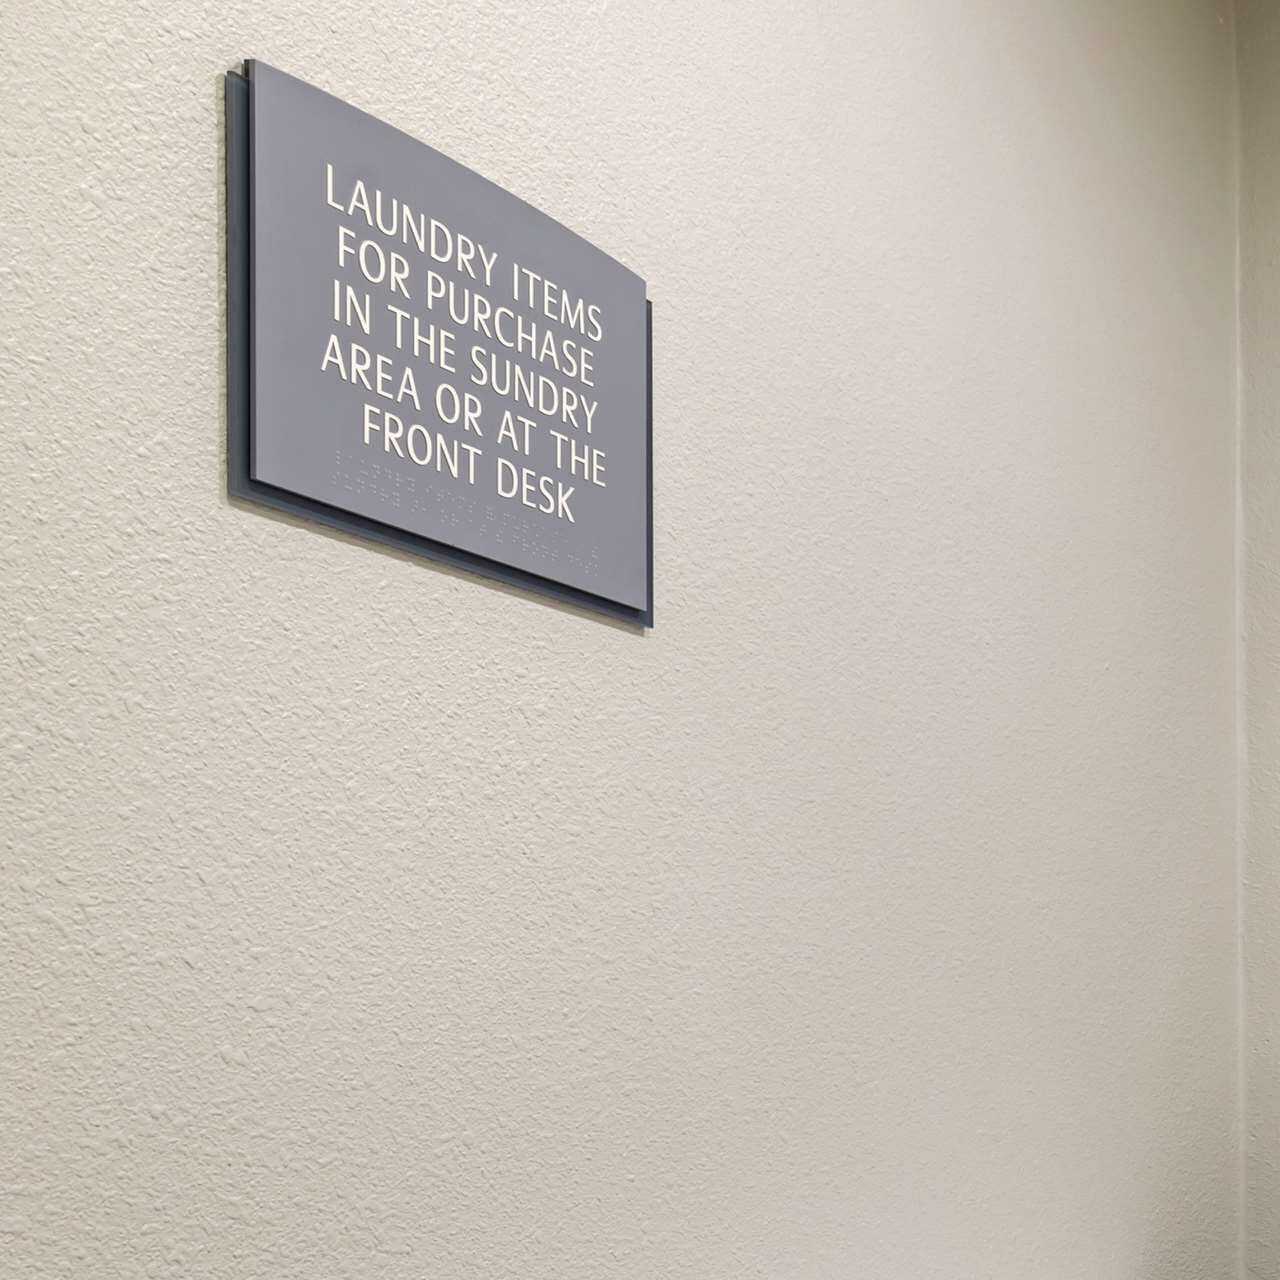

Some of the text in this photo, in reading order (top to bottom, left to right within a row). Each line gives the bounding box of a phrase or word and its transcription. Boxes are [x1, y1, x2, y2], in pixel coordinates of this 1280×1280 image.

[326, 163, 603, 342] LAUNDRY ITEMS
[338, 225, 595, 387] FOR PURCHASE
[320, 334, 607, 488] AREA OR AT THE
[333, 279, 599, 435] IN THE SUNDRY
[363, 402, 576, 524] FRONT DESK
